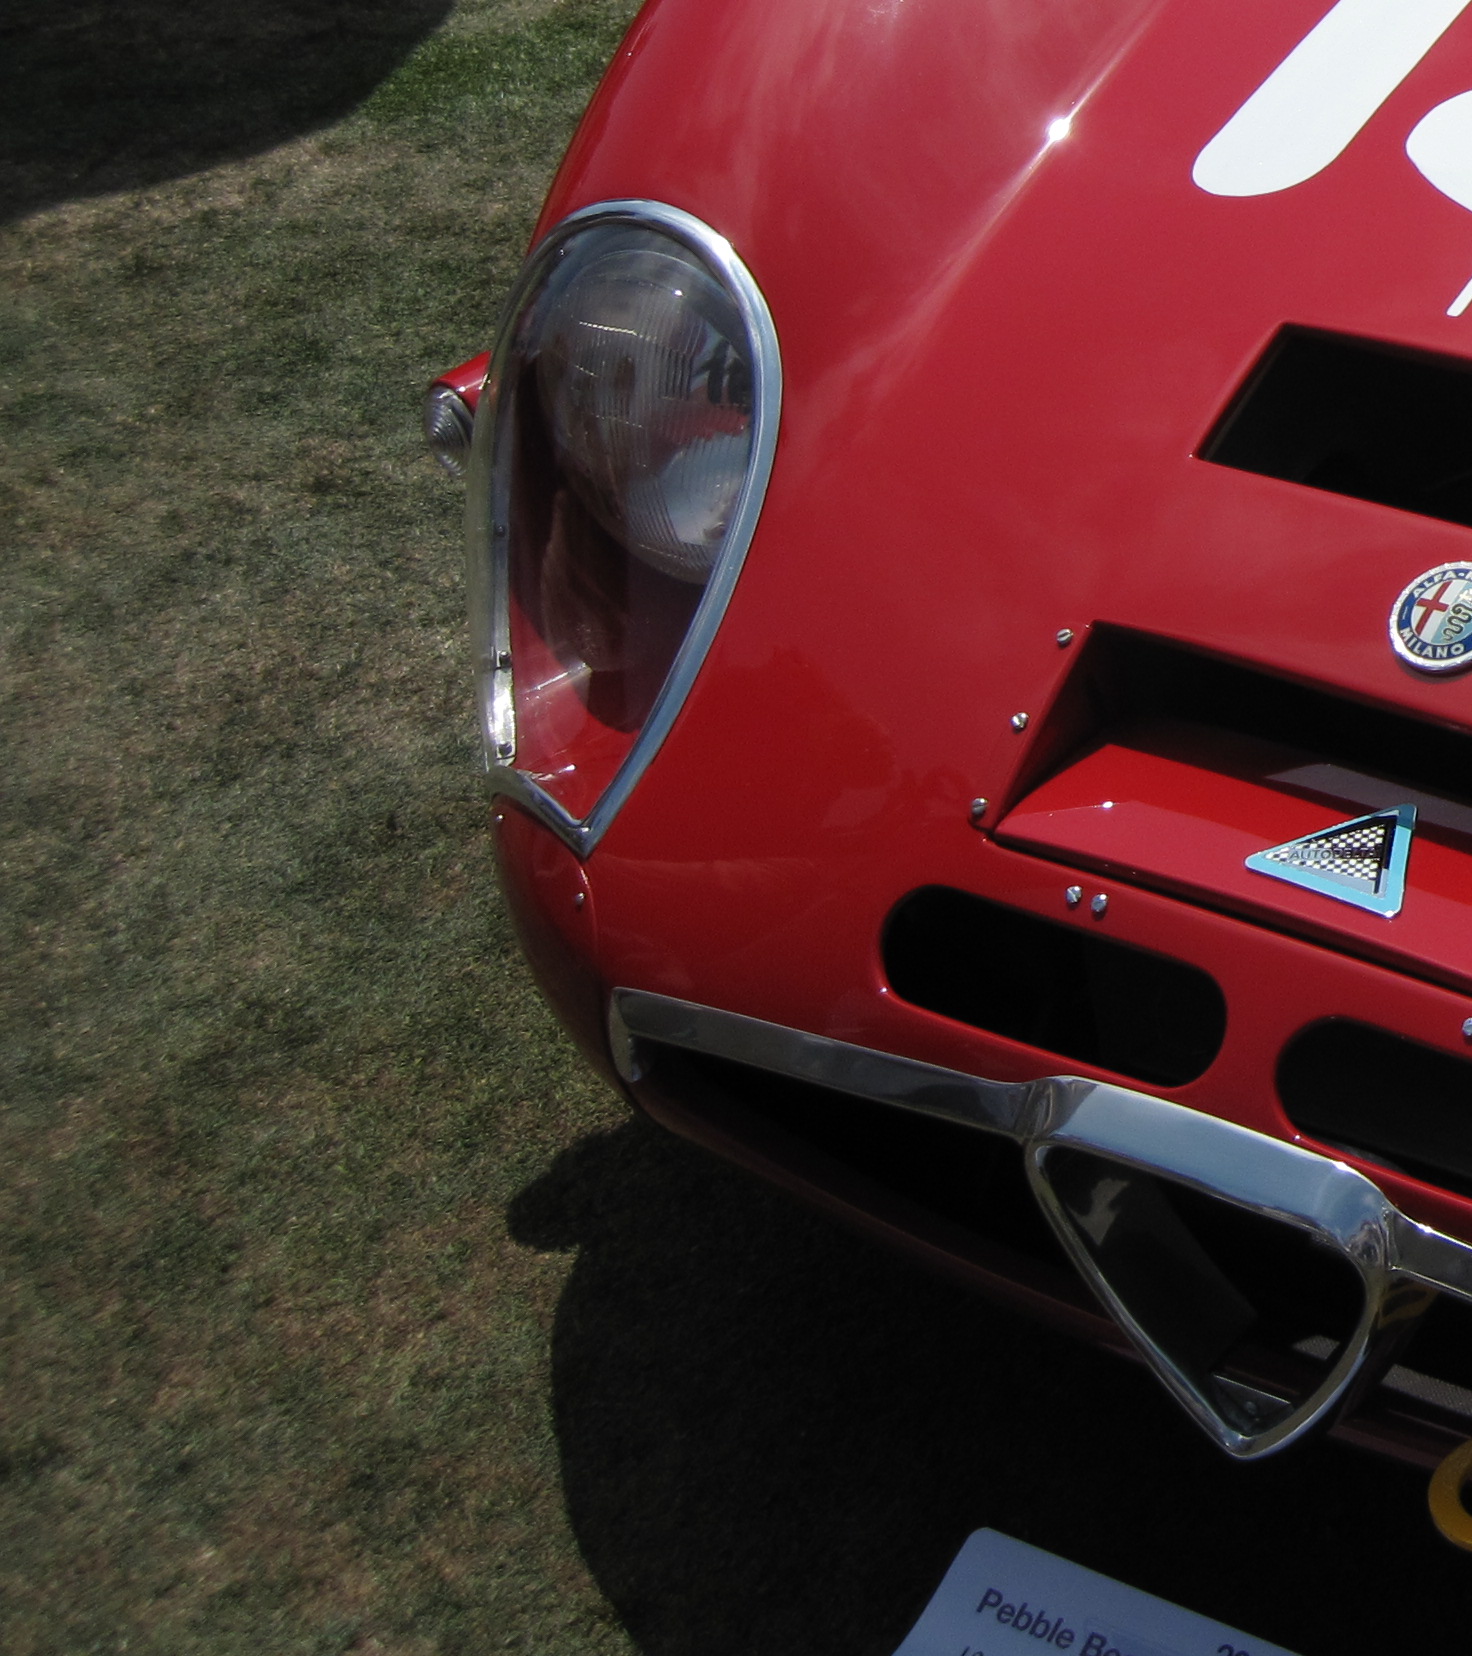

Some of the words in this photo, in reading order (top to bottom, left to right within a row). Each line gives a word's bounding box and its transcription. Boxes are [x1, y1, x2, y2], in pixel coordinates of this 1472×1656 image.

[1400, 628, 1465, 658] MILANO
[1289, 847, 1381, 861] AUTODELTA
[975, 1587, 1075, 1649] Pebble
